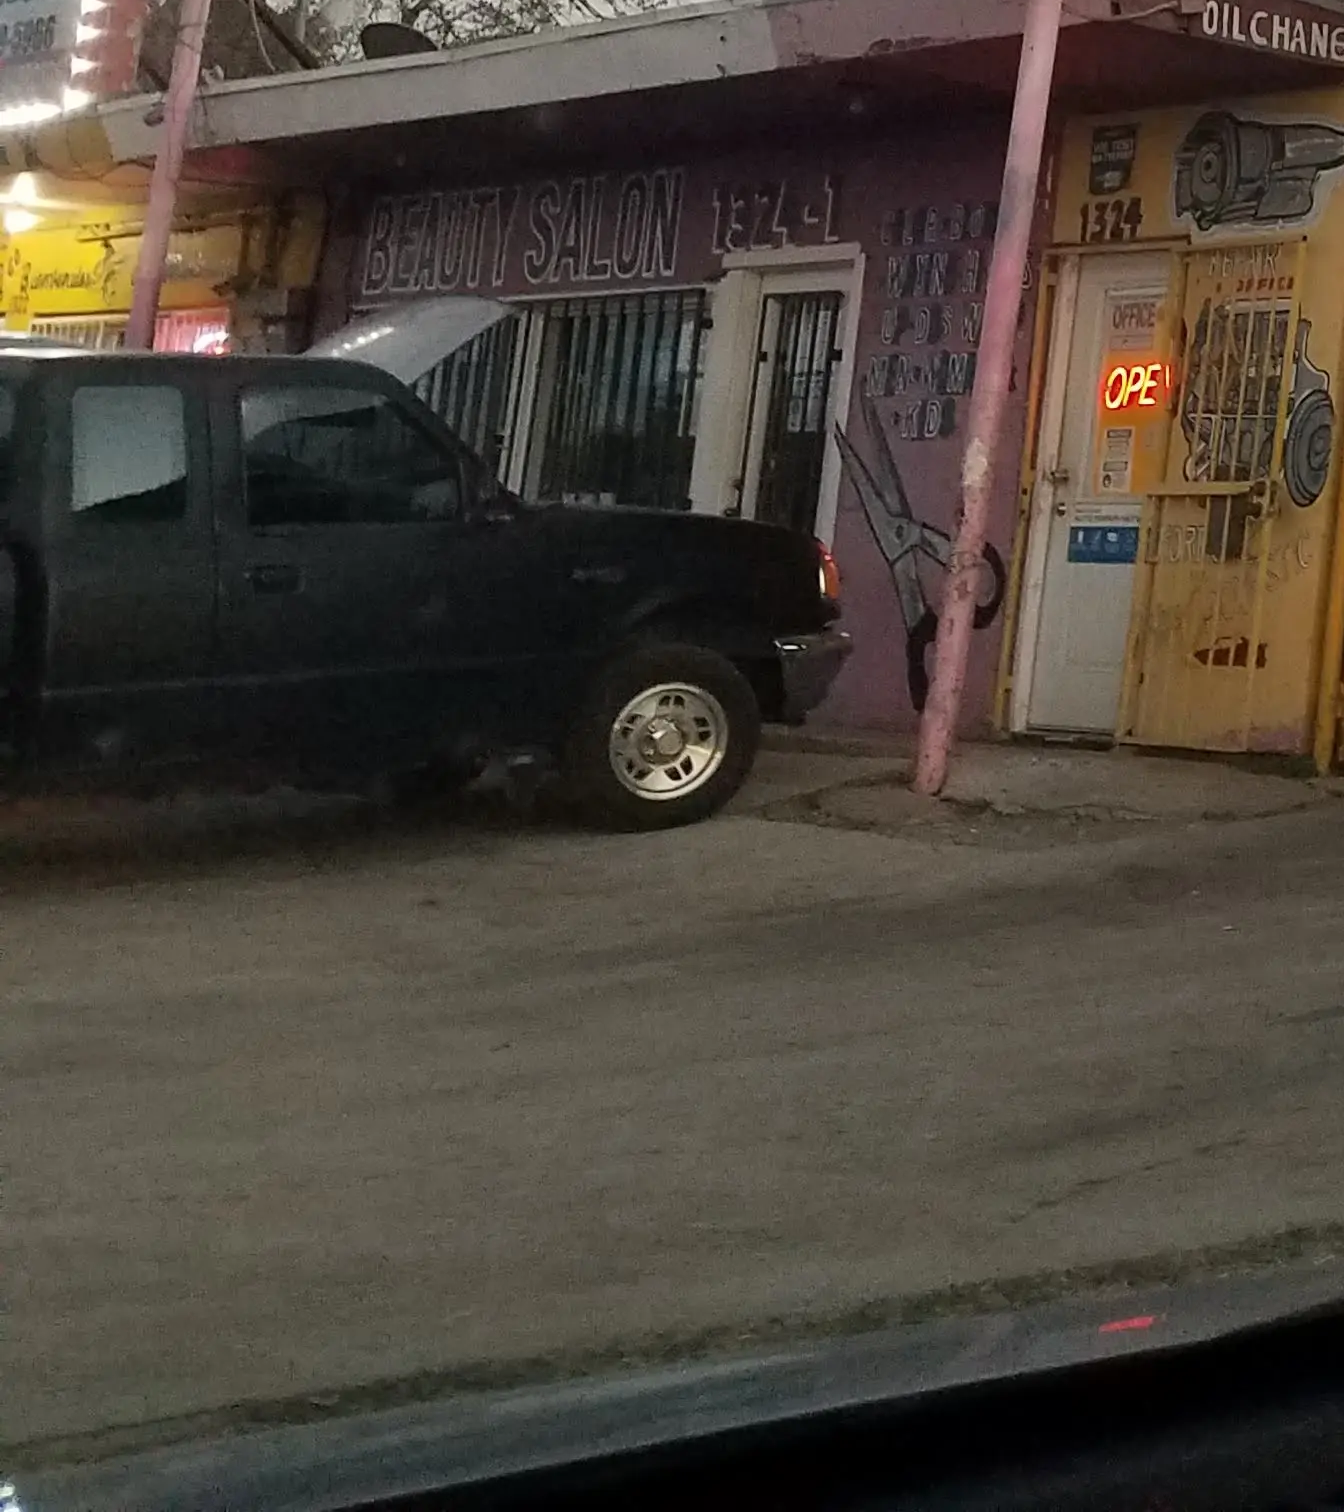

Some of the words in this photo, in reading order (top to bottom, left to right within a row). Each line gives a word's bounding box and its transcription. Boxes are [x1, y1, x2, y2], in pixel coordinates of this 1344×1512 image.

[361, 185, 521, 295] BEAUTY
[524, 169, 685, 285] SALON
[1080, 197, 1144, 243] 1324
[1112, 303, 1156, 328] OFFICE
[1105, 364, 1171, 409] OPE
